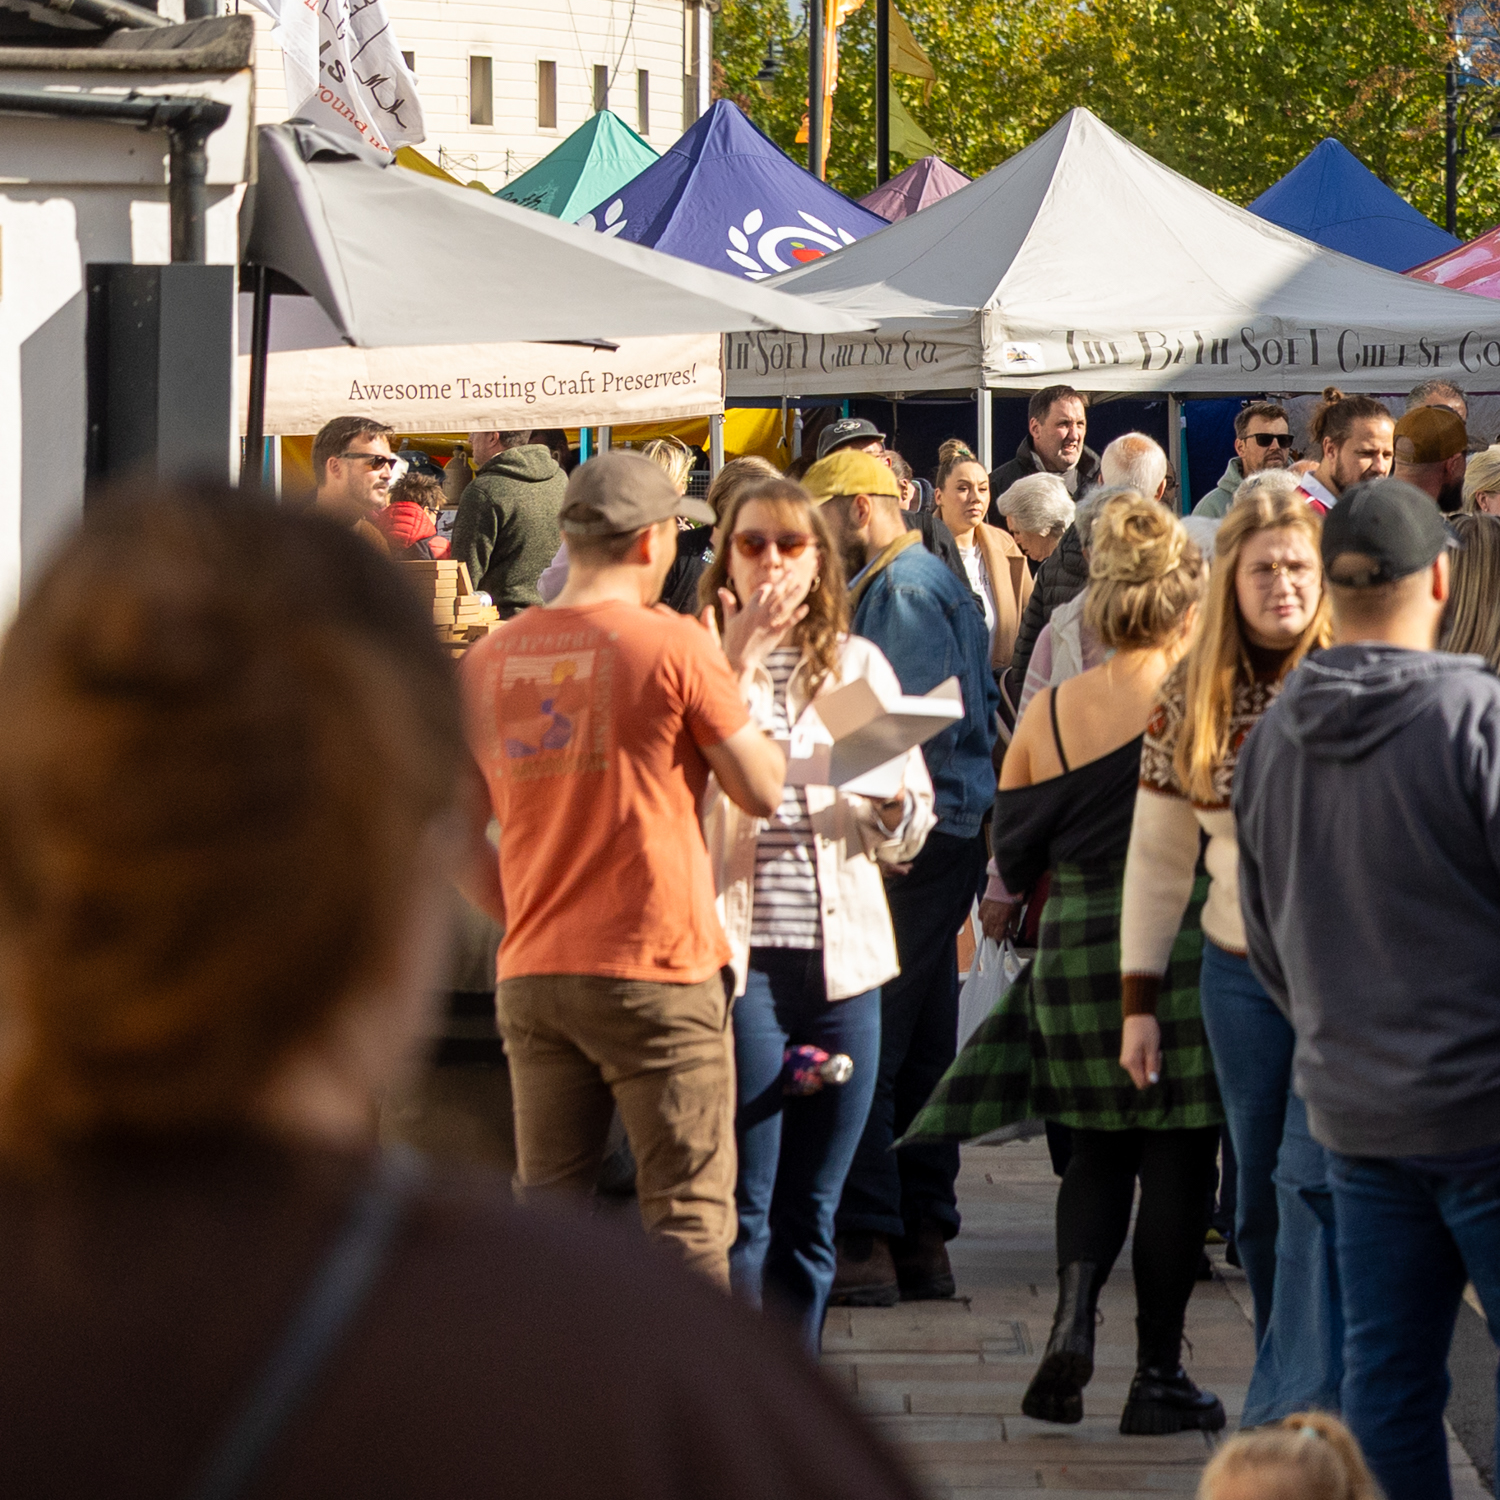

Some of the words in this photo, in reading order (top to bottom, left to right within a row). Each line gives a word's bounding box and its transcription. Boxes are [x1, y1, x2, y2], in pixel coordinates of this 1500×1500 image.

[1050, 328, 1137, 371] THE
[1133, 329, 1230, 371] BATH
[1240, 327, 1329, 373] SOFT
[1337, 328, 1451, 374] CHEESE
[349, 379, 452, 401] Awesome
[456, 375, 537, 404] Tasting
[541, 370, 596, 397] Craft
[601, 362, 698, 393] Preserves!
